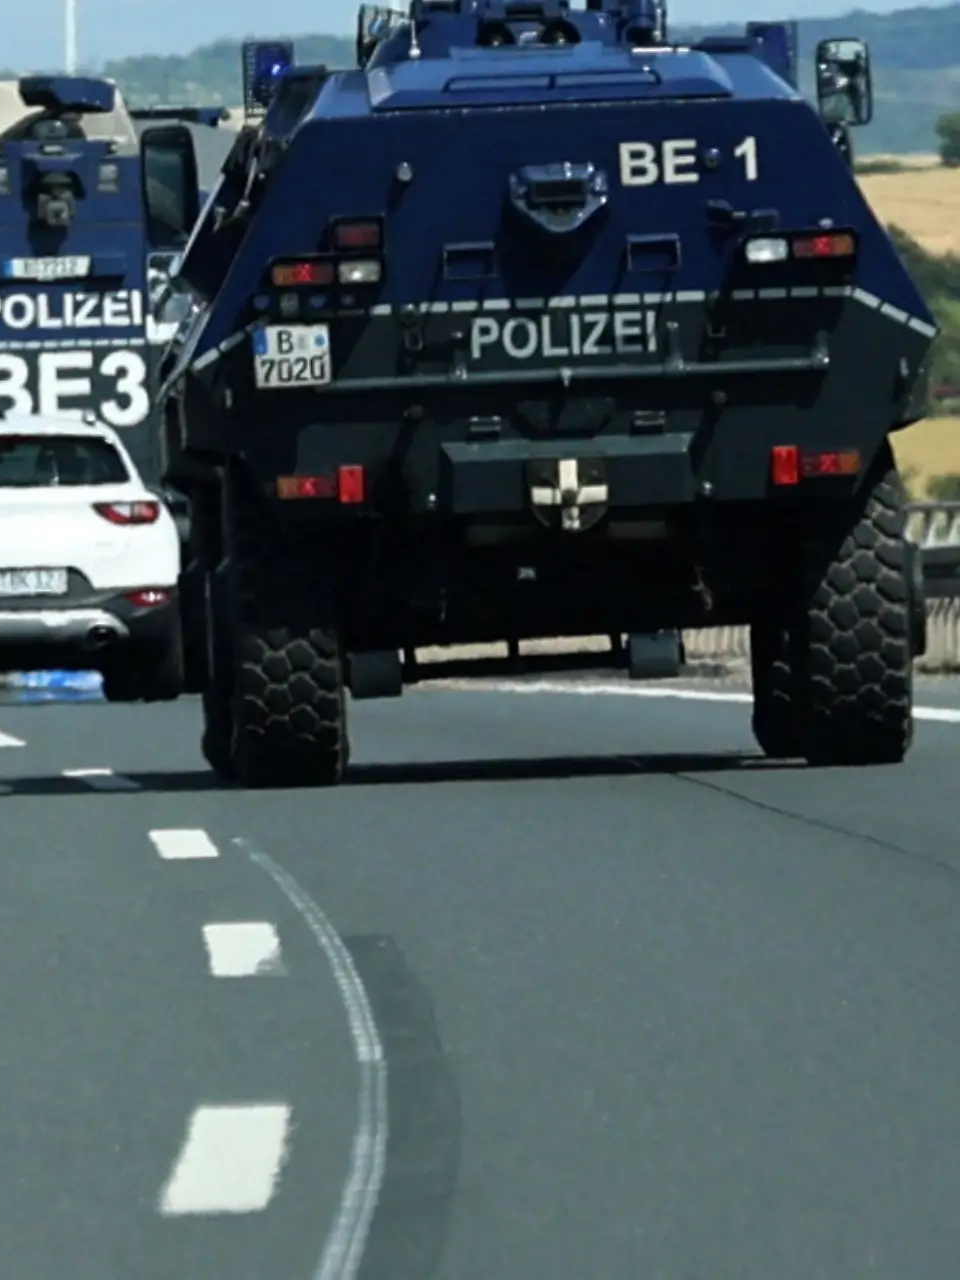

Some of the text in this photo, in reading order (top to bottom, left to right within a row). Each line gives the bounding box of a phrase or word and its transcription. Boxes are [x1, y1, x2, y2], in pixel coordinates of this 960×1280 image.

[619, 135, 758, 187] BE 1
[277, 329, 294, 355] B
[471, 310, 657, 359] POLIZEI
[260, 355, 326, 384] 7020
